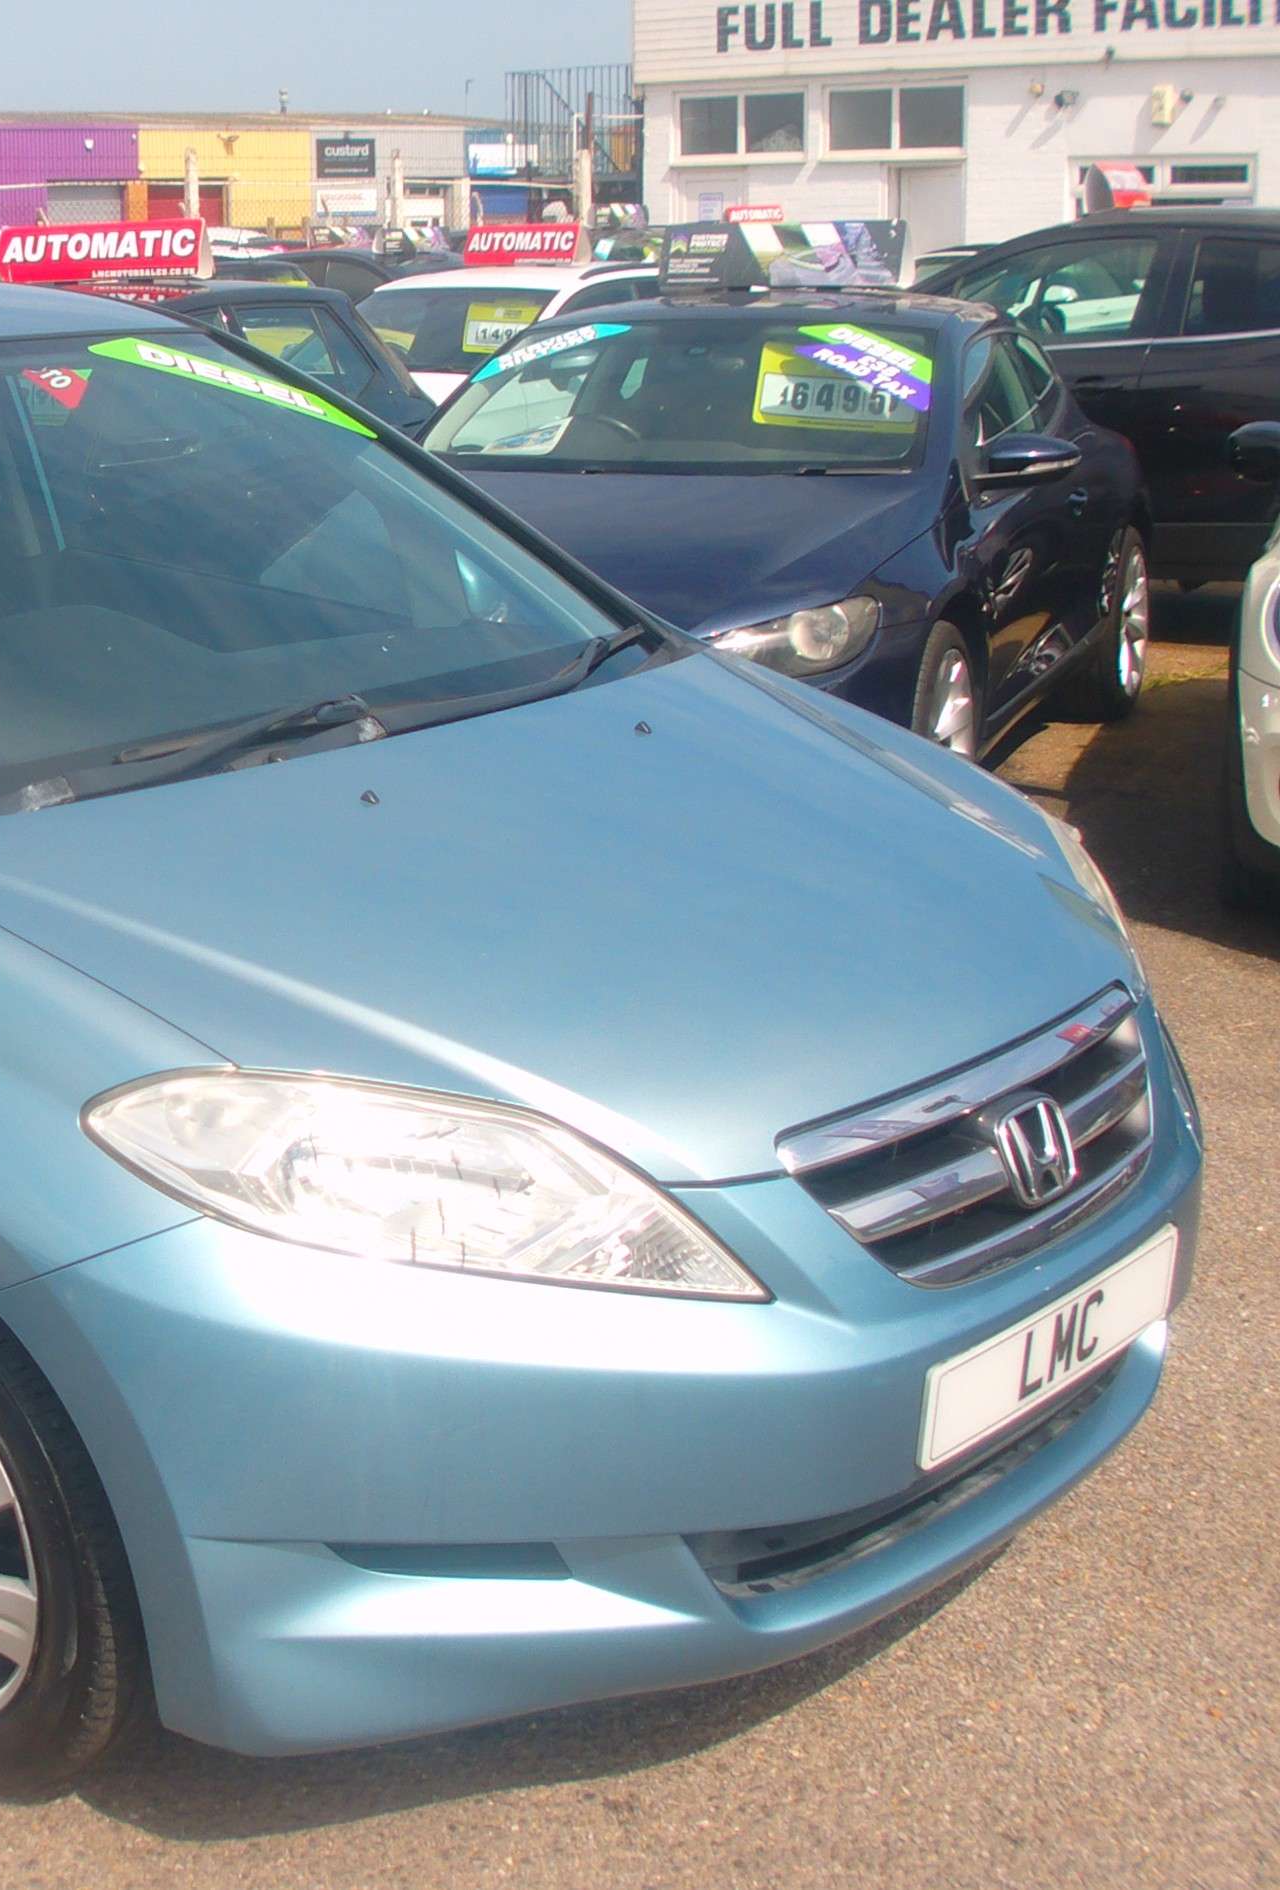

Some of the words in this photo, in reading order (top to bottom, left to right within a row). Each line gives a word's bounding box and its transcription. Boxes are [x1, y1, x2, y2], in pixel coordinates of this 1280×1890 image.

[716, 0, 833, 54] FULL
[858, 0, 1072, 45] DEALER
[1093, 0, 1280, 33] FACILI
[323, 143, 370, 157] custard
[730, 208, 783, 222] AUTOMATIC
[1, 228, 195, 264] AUTOMATIC
[467, 230, 575, 252] AUTOMATIC
[827, 326, 917, 371] DIESEL
[135, 343, 327, 416] DIESEL
[812, 348, 870, 377] ROAD
[871, 373, 917, 399] TAX
[1017, 1289, 1105, 1402] LMC
